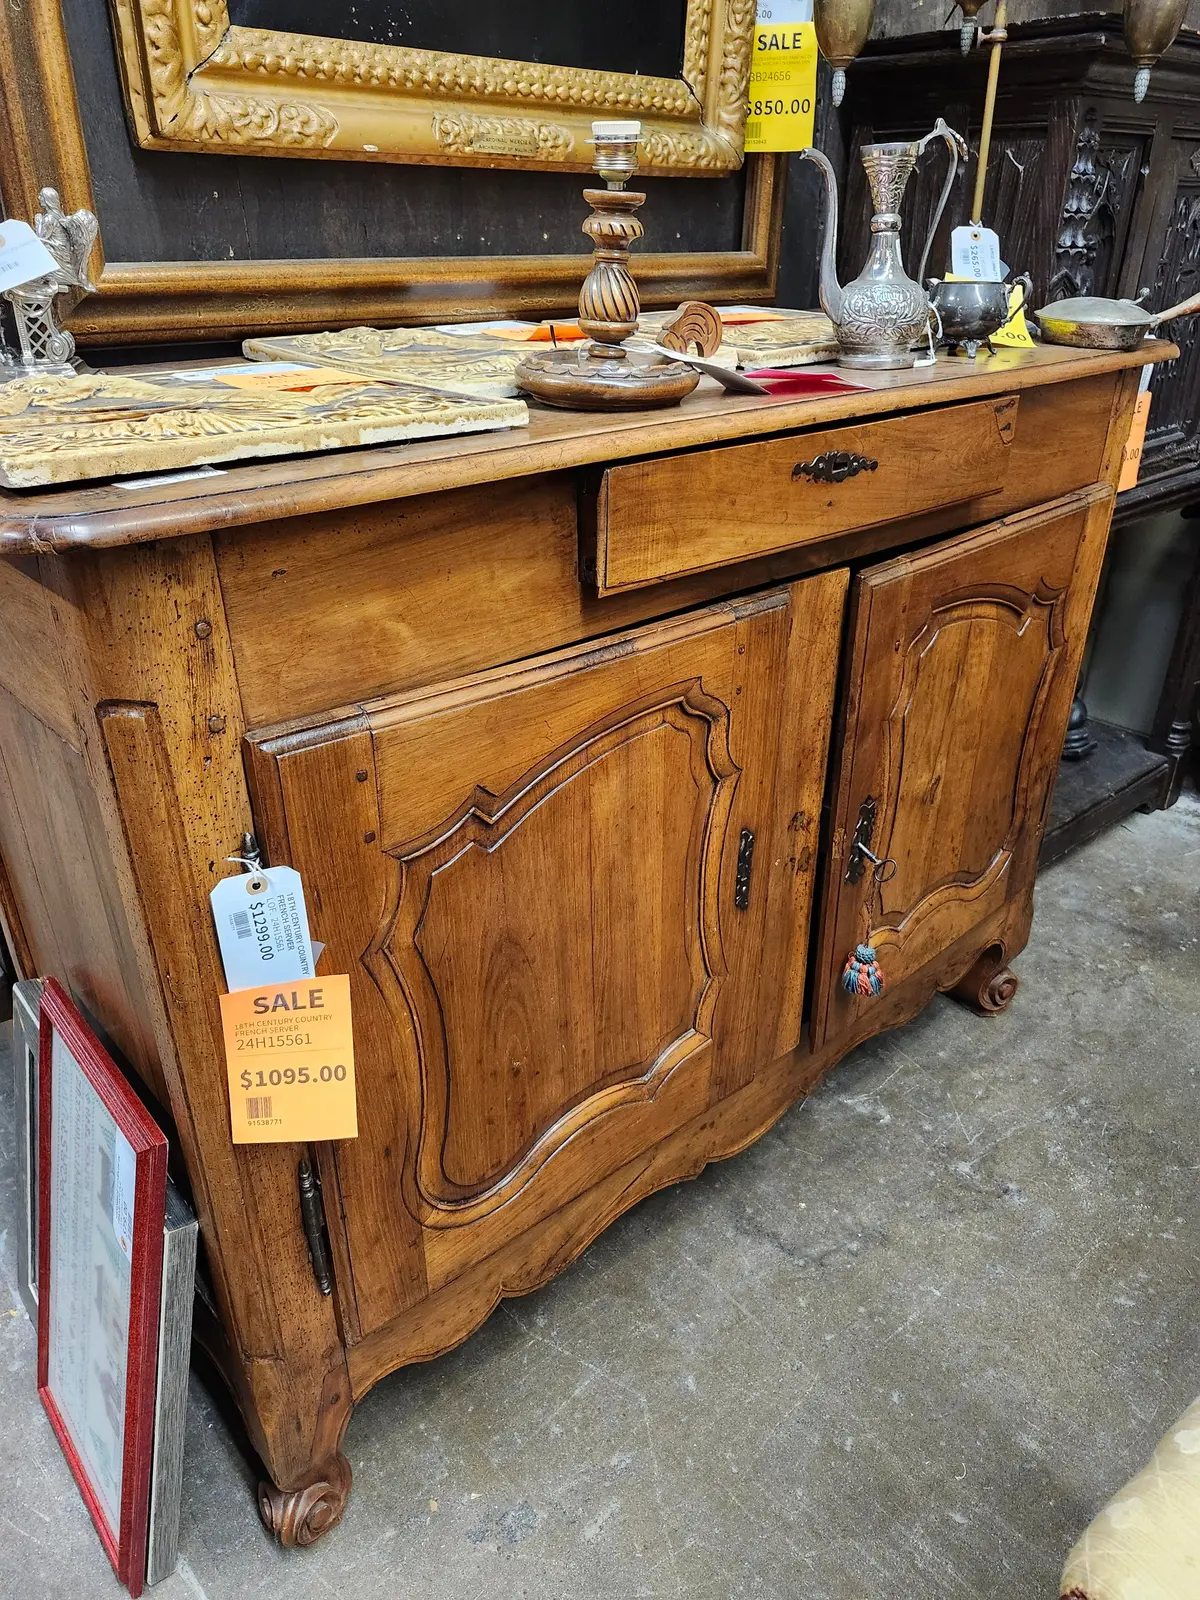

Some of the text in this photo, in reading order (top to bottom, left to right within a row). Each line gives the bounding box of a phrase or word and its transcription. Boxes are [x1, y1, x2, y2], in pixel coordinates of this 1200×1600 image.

[757, 32, 803, 52] SALE
[747, 98, 811, 118] $850.00
[970, 245, 982, 278] $265.00
[248, 902, 275, 961] $1299.00
[270, 917, 285, 952] 24H15561
[276, 894, 295, 951] FRENCH SERVER
[286, 892, 310, 975] 18TH CENTURY COUNTRY
[252, 988, 325, 1015] SALE
[234, 1014, 334, 1031] 18TH CENTURY COUNTRY
[234, 1024, 300, 1038] FRENCH SERVER
[236, 1033, 313, 1051] 24H15561
[240, 1064, 348, 1090] $1095.00
[247, 1118, 282, 1127] 91538771
